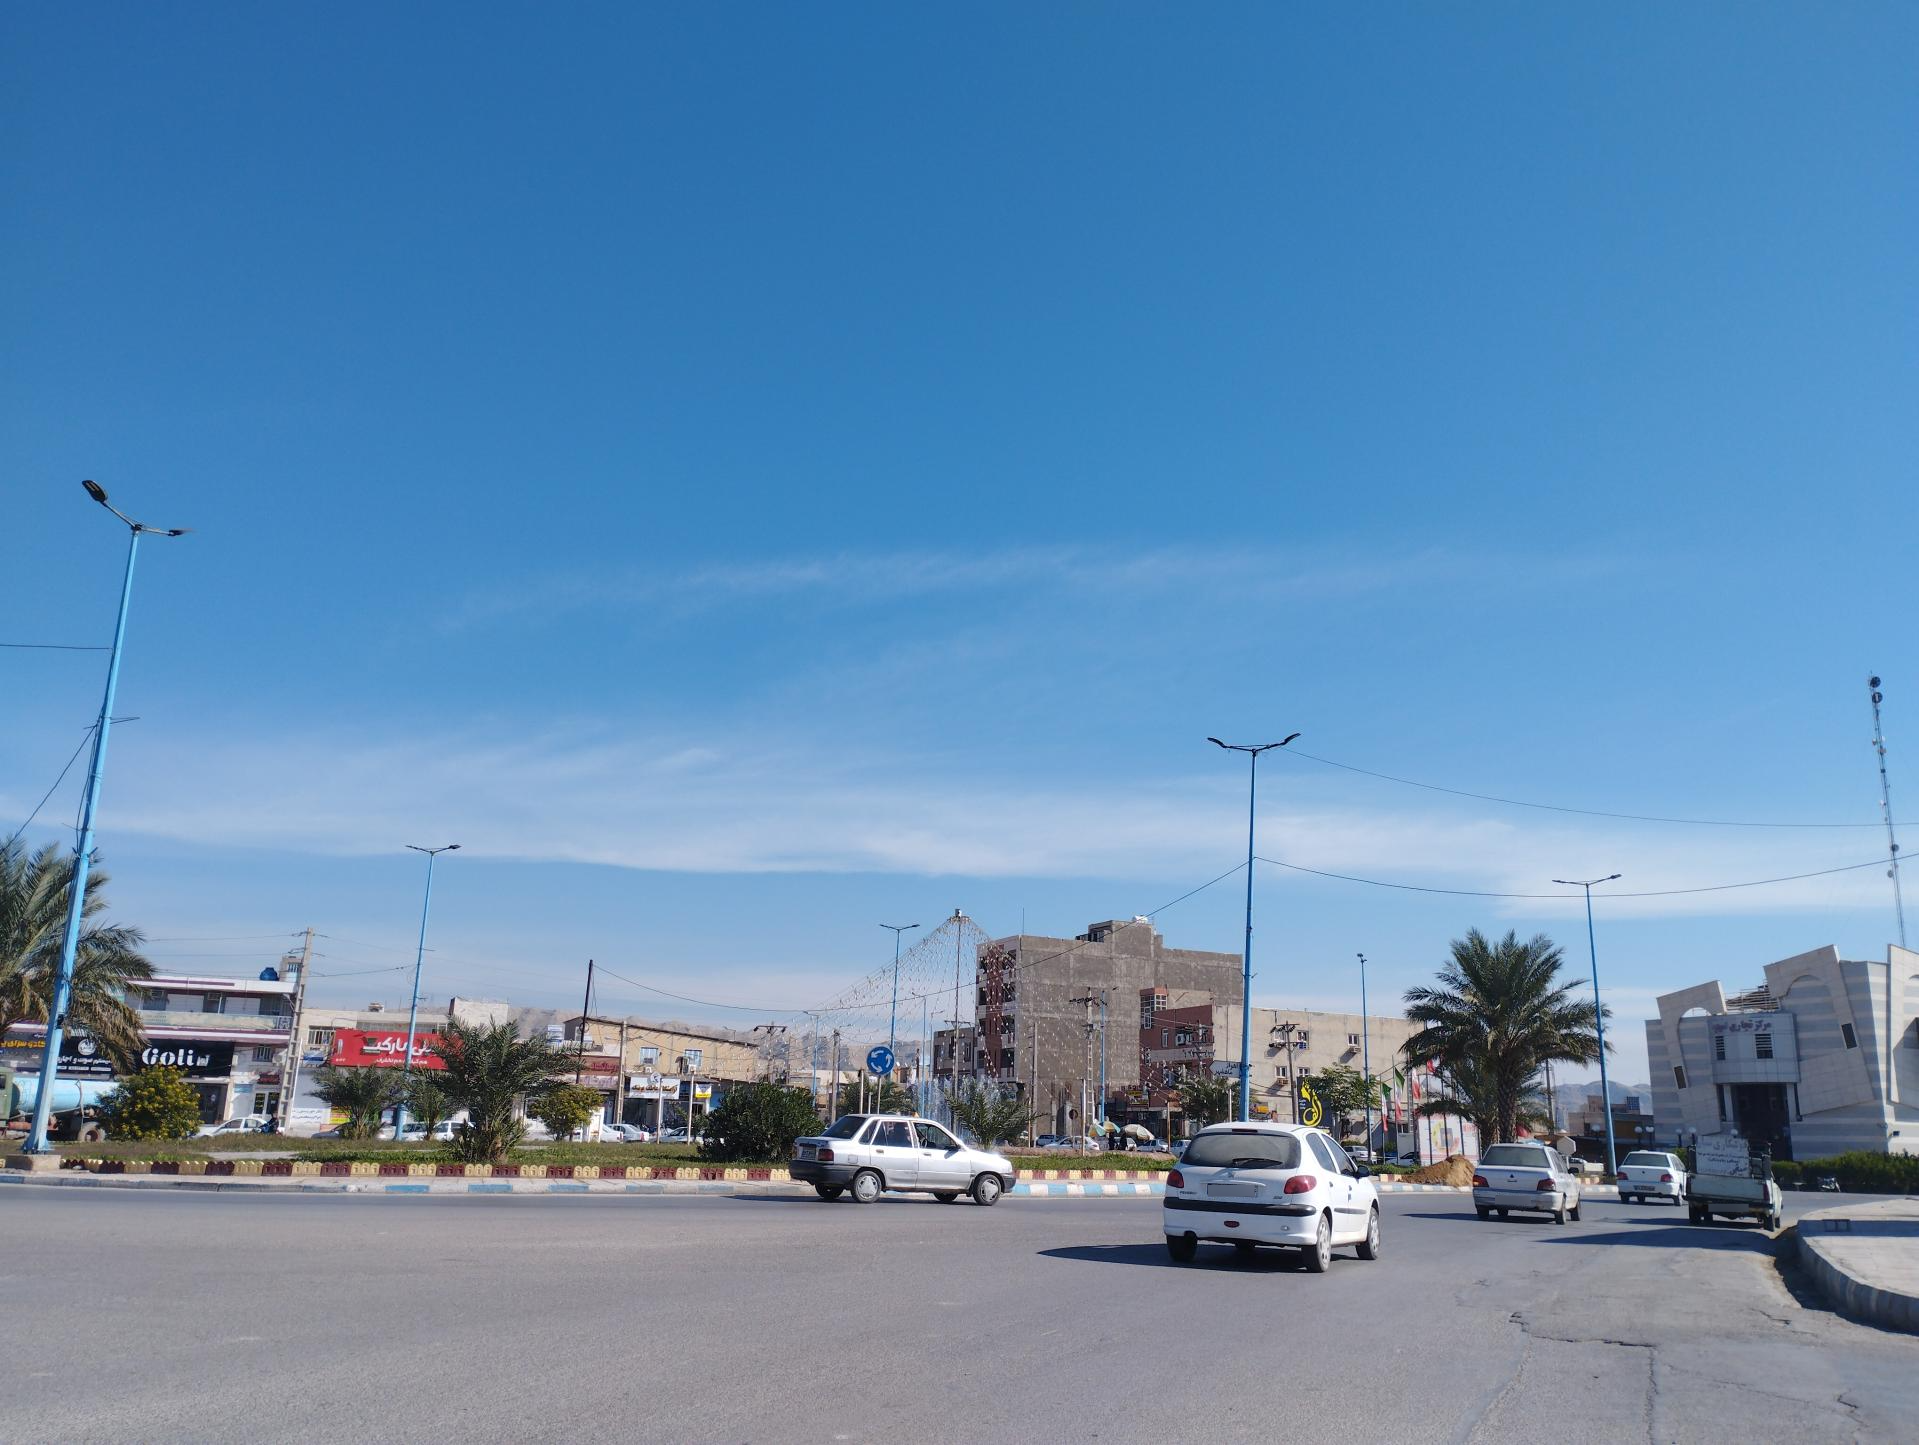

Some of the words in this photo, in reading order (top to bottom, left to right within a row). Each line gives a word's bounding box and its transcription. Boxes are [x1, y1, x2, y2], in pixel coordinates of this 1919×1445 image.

[1728, 1019, 1753, 1032] تجاری
[1753, 1019, 1772, 1032] مرکز
[142, 1048, 194, 1066] Goli
